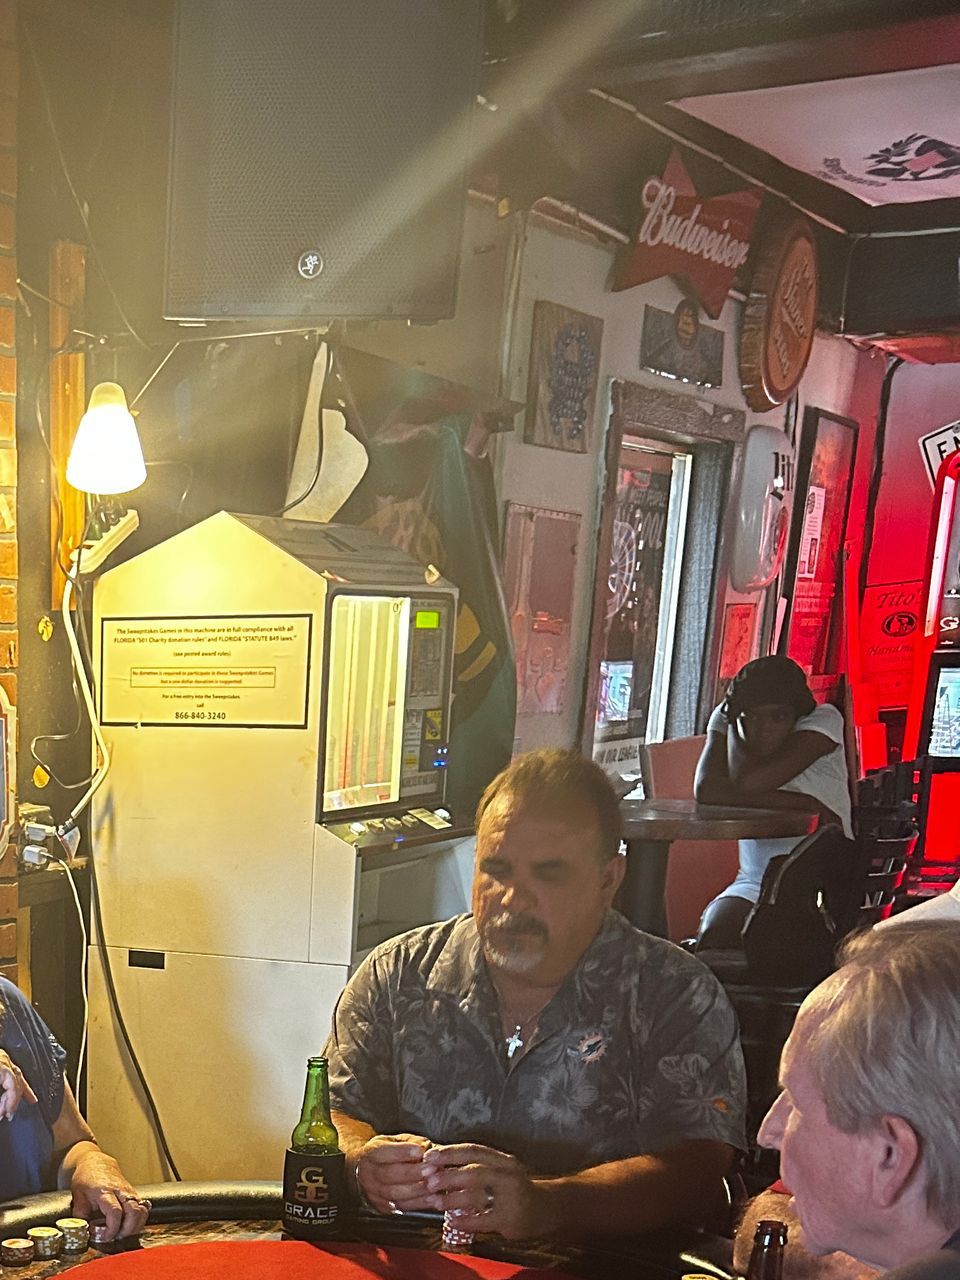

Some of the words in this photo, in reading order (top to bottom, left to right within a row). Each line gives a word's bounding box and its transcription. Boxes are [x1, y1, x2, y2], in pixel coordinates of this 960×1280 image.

[639, 178, 750, 269] Budweiser
[175, 711, 226, 720] 866-840-3240
[284, 1201, 338, 1218] GRACE
